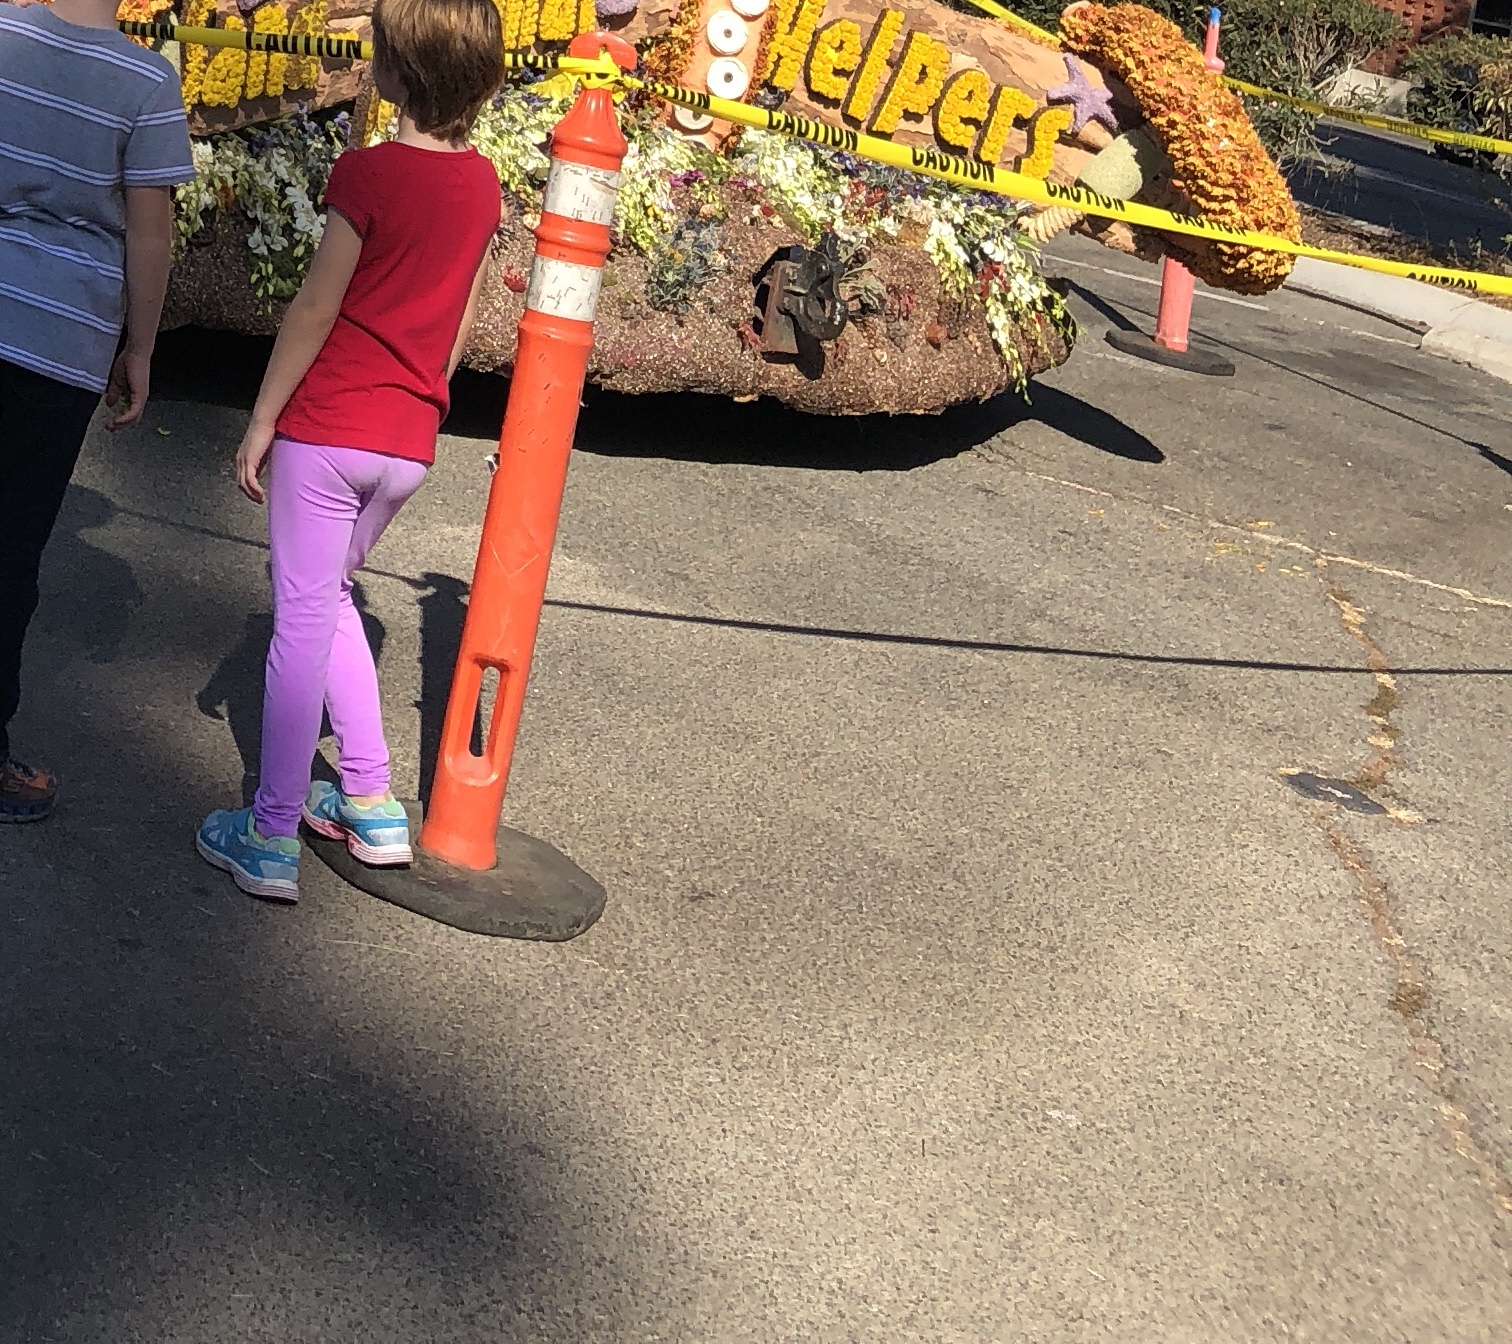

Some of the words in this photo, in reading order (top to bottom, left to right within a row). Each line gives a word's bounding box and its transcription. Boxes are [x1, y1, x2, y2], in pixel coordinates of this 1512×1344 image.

[767, 110, 858, 152] CAUTION
[911, 148, 996, 184] CAUTION
[1044, 180, 1127, 213] CAUTION
